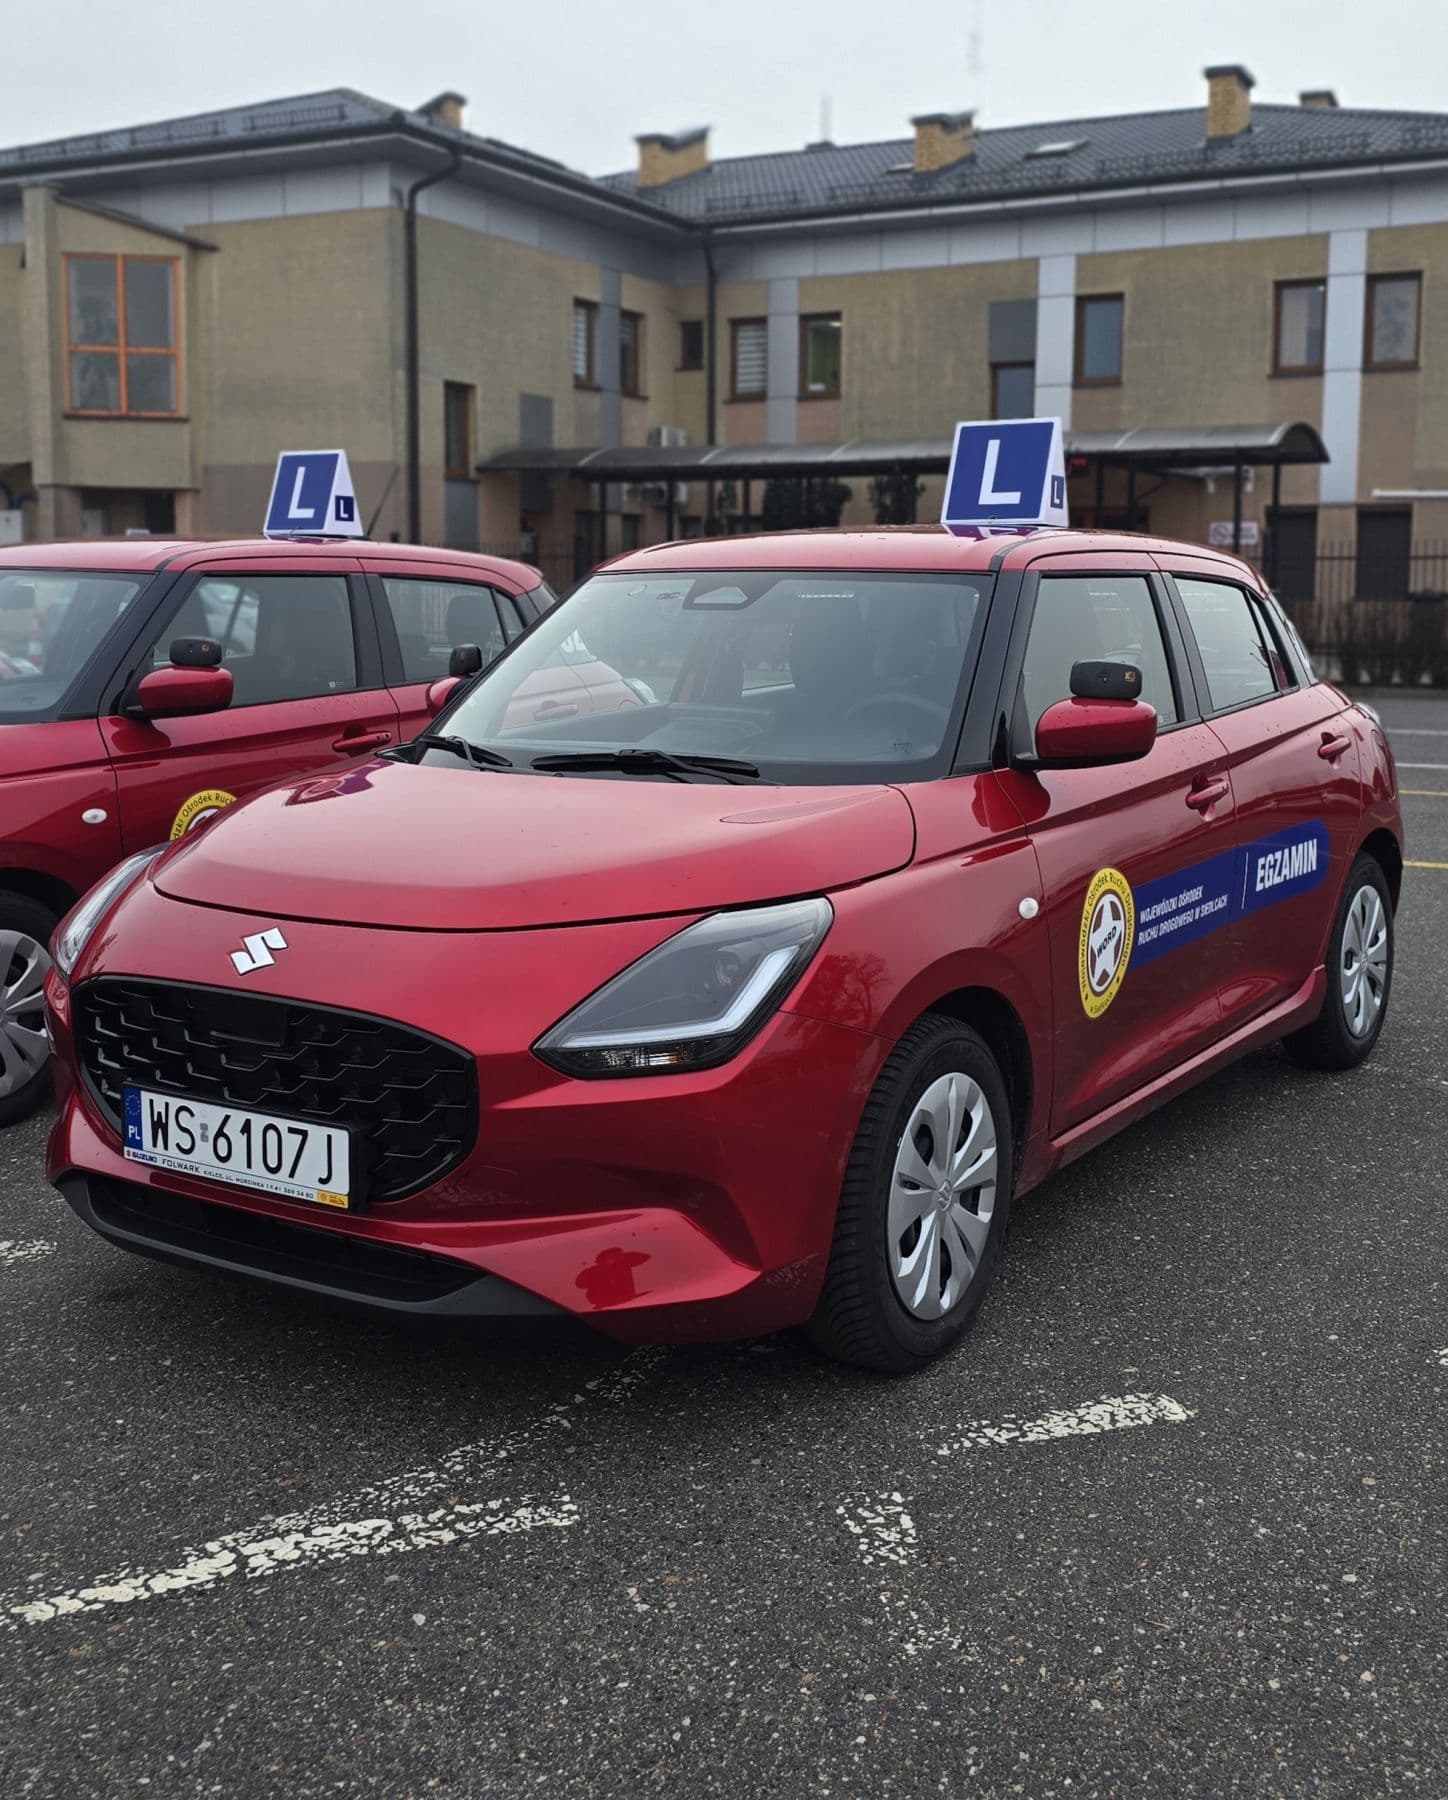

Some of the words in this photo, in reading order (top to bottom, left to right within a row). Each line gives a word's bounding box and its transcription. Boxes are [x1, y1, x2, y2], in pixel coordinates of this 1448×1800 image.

[978, 439, 1021, 505] L
[287, 466, 315, 519] L
[340, 499, 349, 518] L
[1053, 479, 1061, 505] L
[182, 793, 213, 818] Ośrodek
[1255, 838, 1318, 893] EGZAMIN
[1137, 925, 1159, 946] RUCHU
[1158, 909, 1194, 937] DROGOWEGO
[1194, 906, 1201, 921] W
[1200, 894, 1229, 918] SIEDLCACH
[1140, 898, 1179, 924] WOJEWÓDZKI
[1178, 886, 1204, 908] OŚRODEK
[1097, 925, 1117, 959] WORD
[128, 1125, 141, 1140] PL
[149, 1098, 196, 1155] WS
[212, 1114, 333, 1185] 6107J
[132, 1151, 158, 1164] SUZUKI
